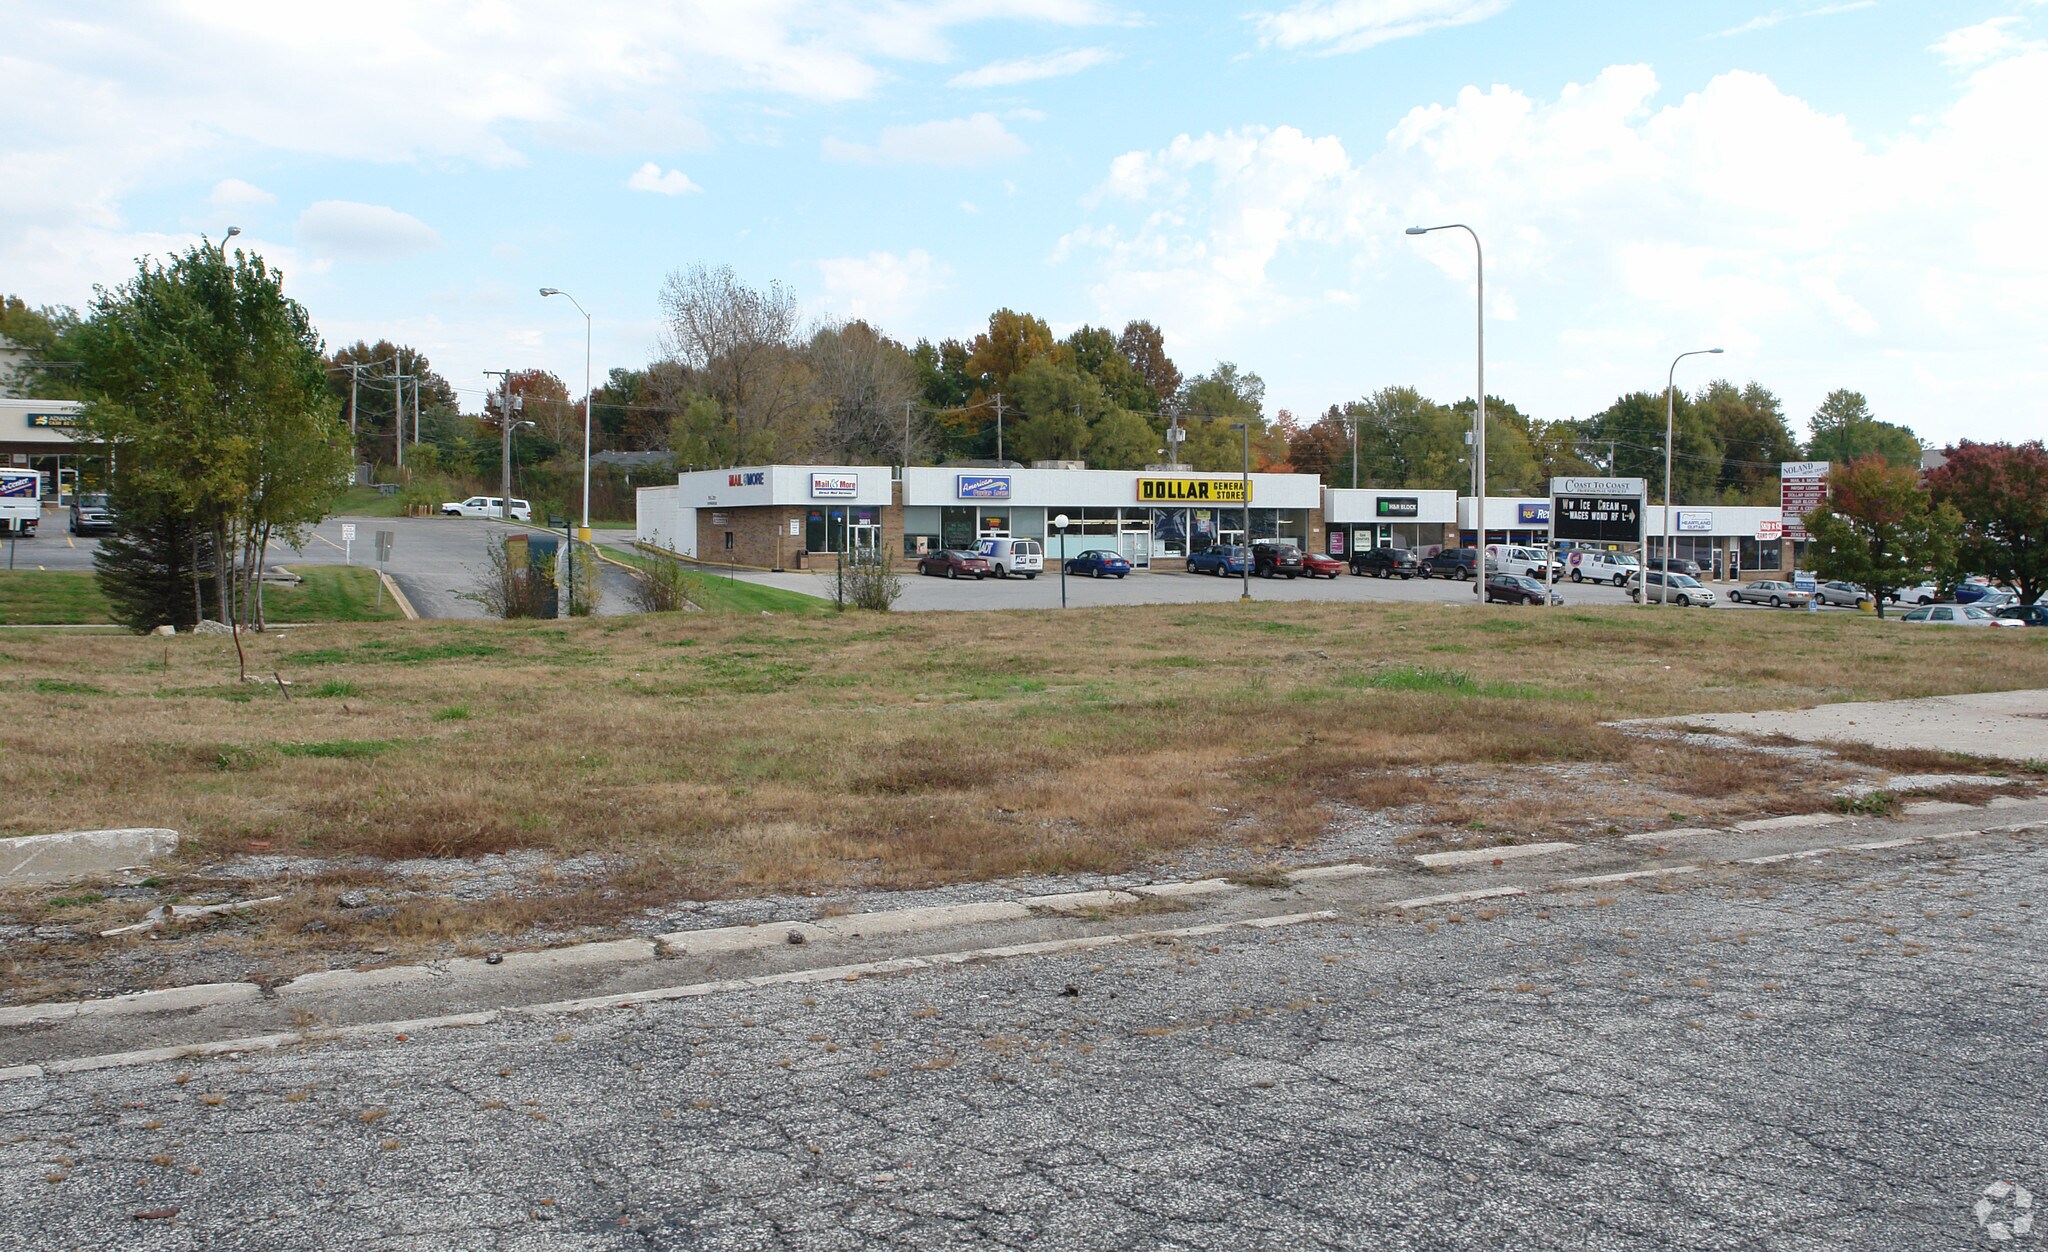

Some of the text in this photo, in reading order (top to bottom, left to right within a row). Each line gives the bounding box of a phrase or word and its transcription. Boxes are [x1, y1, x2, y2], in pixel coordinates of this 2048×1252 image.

[1783, 463, 1813, 474] NOLAND
[729, 474, 743, 486] MAIL
[747, 472, 764, 485] MORE
[814, 478, 856, 489] Mail & More
[963, 479, 993, 492] American
[1143, 482, 1209, 499] DOLLAR
[1213, 482, 1245, 491] GENERA
[1580, 498, 1591, 510] ICE
[1522, 510, 1535, 519] RAC
[980, 542, 993, 554] ADT
